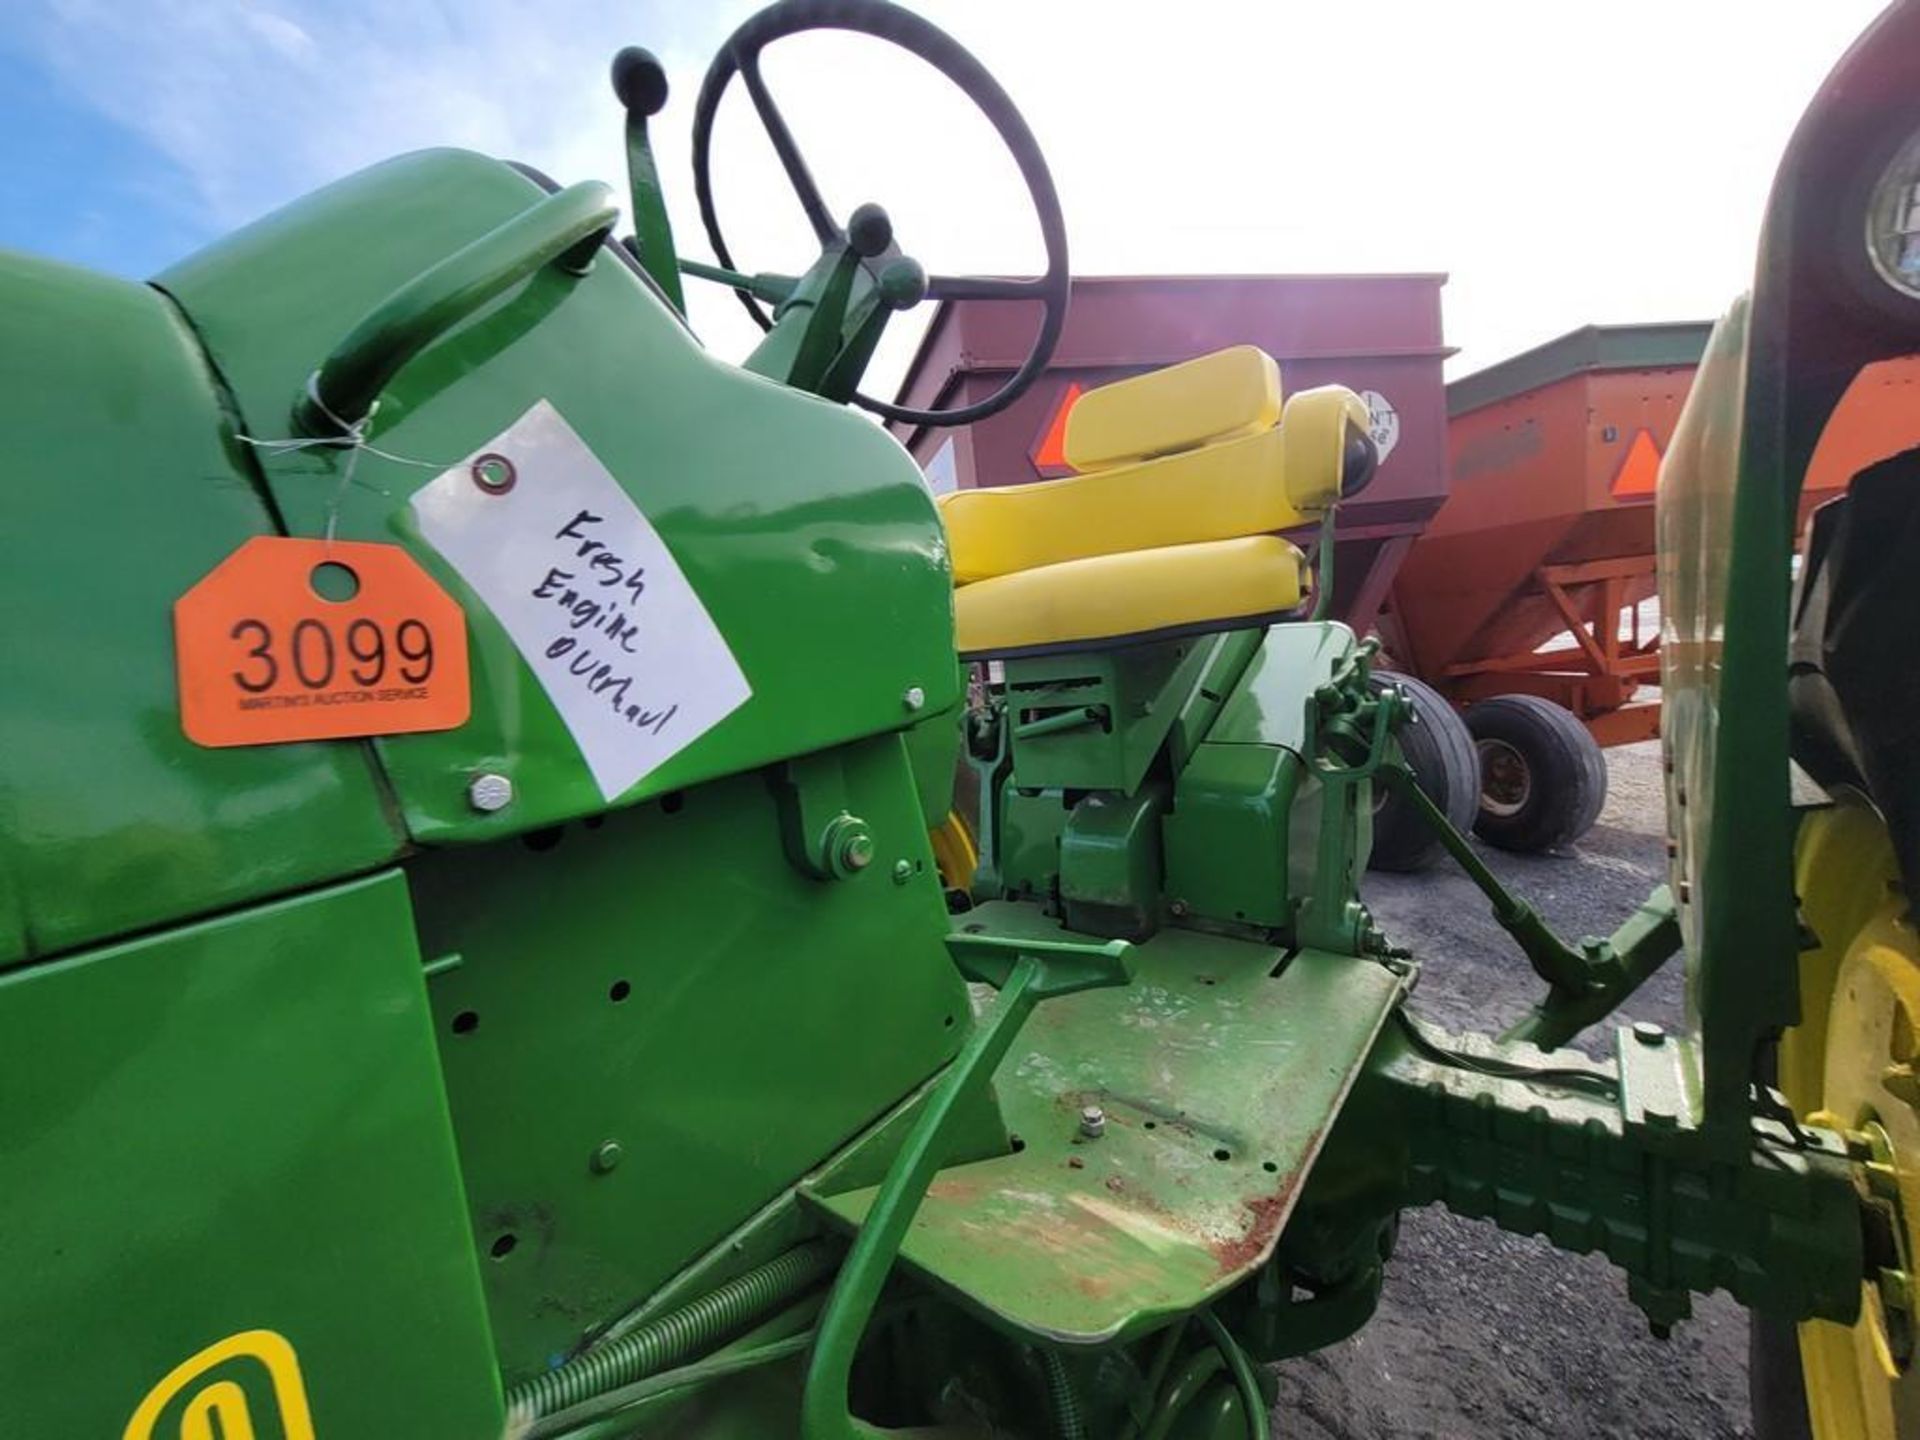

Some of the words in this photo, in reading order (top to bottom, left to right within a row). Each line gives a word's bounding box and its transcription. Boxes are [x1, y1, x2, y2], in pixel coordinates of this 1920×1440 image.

[555, 510, 644, 605] Fresh
[532, 568, 638, 653] Engine
[229, 618, 434, 693] 3099
[377, 687, 429, 702] SERVICE
